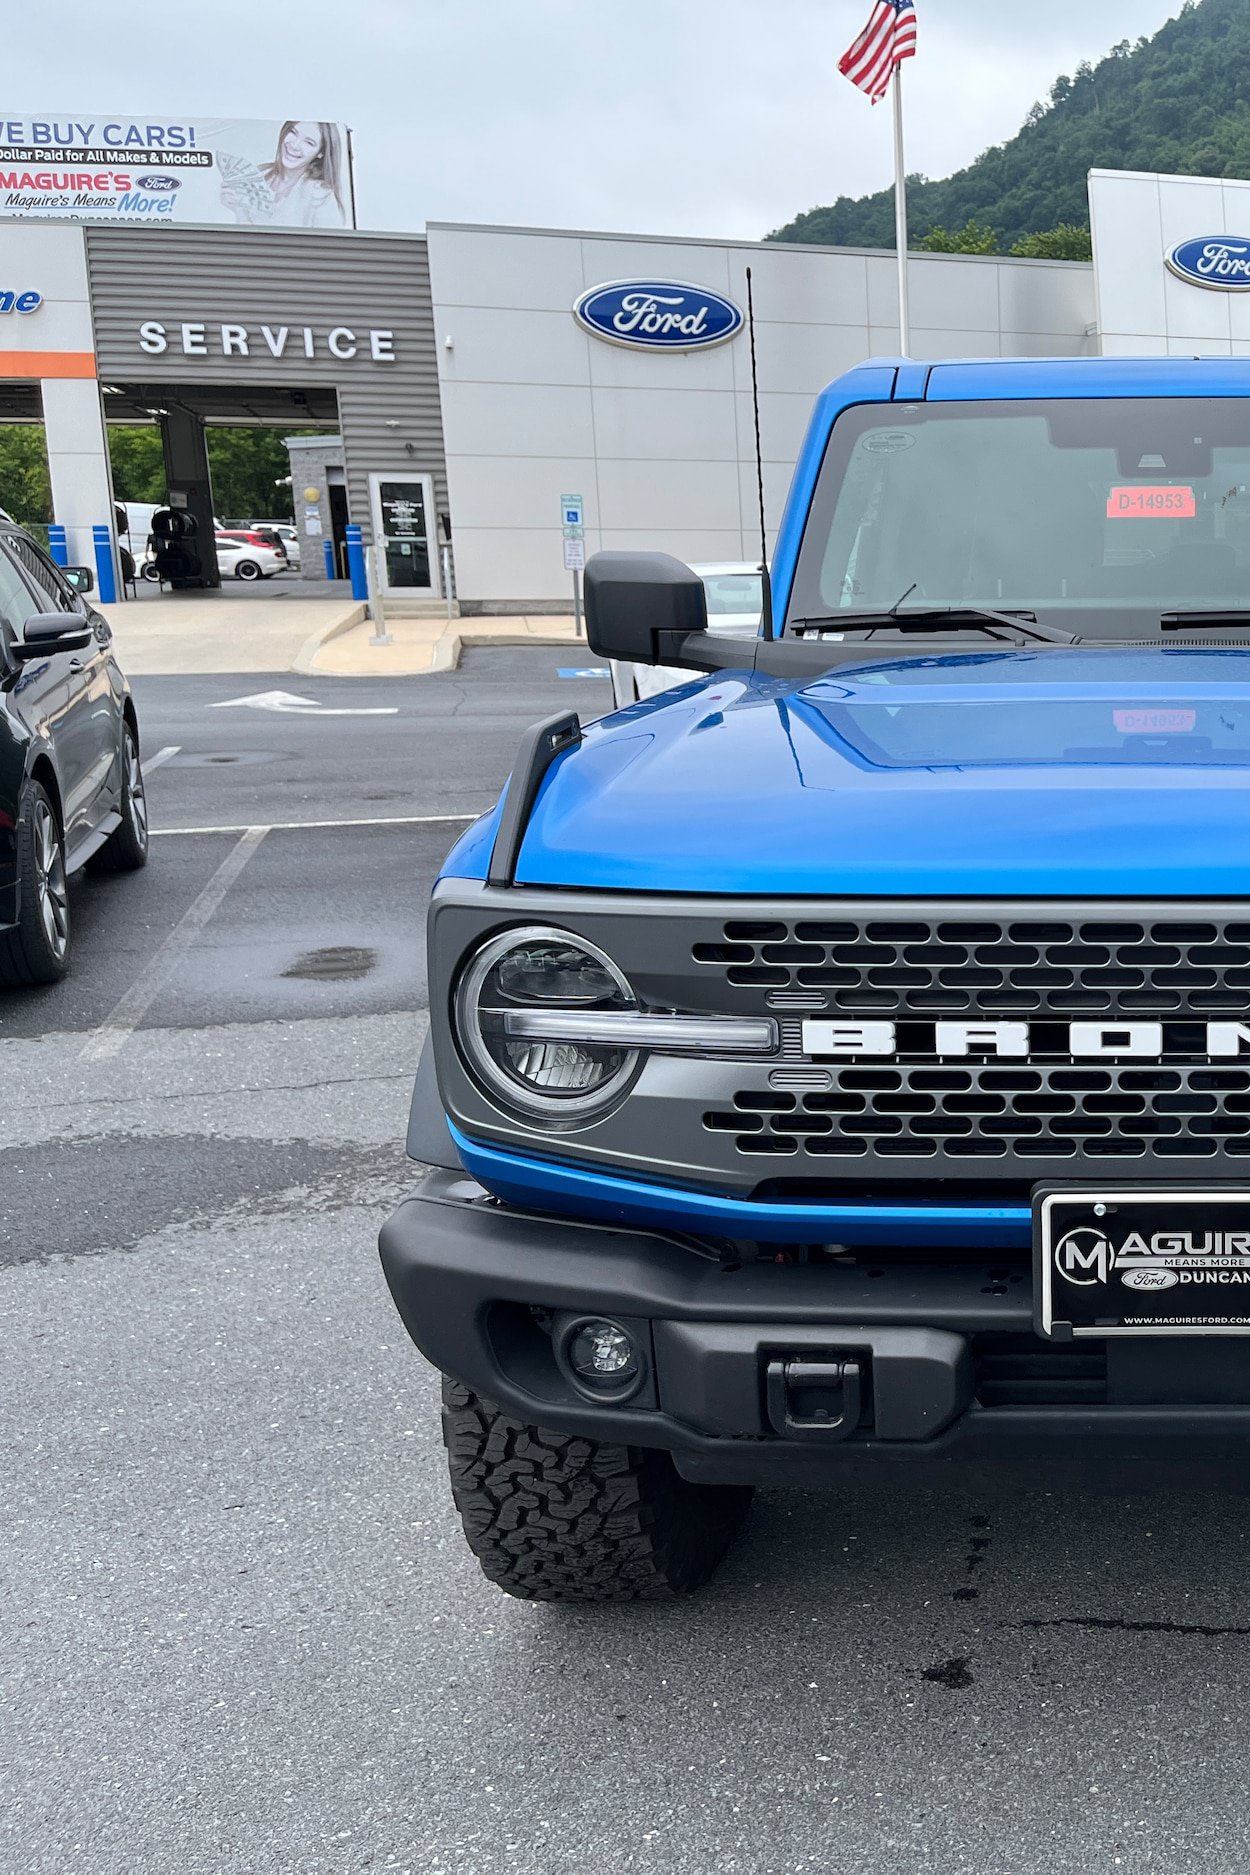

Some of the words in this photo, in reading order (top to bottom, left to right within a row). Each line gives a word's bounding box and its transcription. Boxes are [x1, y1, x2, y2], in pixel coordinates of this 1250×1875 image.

[0, 121, 24, 143] E
[32, 122, 95, 145] BUY
[103, 123, 196, 148] CARS!
[35, 149, 63, 160] Paid
[66, 150, 84, 161] for
[87, 150, 104, 162] All
[106, 151, 147, 163] Makes
[149, 152, 160, 163] &
[162, 152, 209, 164] Models
[0, 171, 132, 191] MAGUIRE'S
[144, 177, 173, 189] Ford
[5, 193, 70, 210] Maguire's
[73, 193, 117, 207] Means
[117, 192, 177, 213] More!
[612, 292, 709, 335] Ford
[139, 320, 396, 361] SERVICE
[1118, 493, 1185, 510] D-14953
[1163, 1257, 1206, 1267] MEANS
[1210, 1257, 1246, 1267] MORE
[1132, 1272, 1168, 1287] Ford
